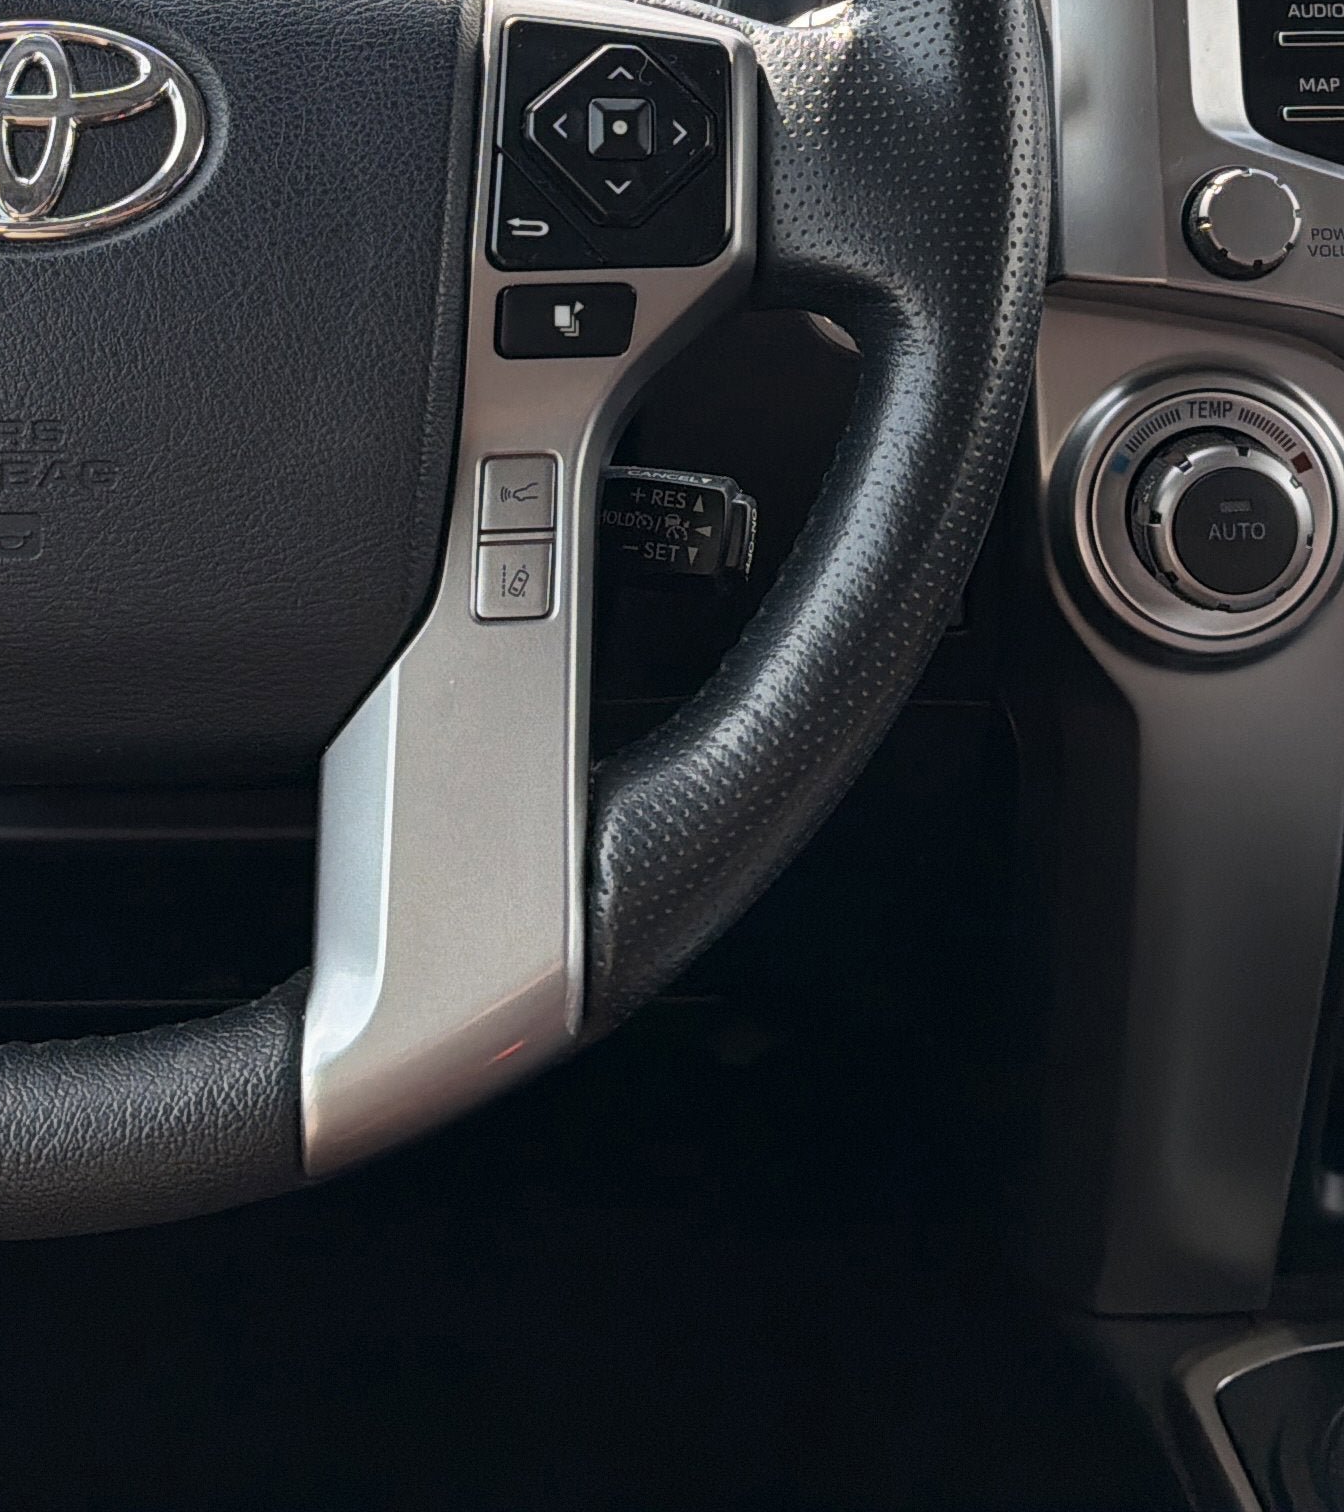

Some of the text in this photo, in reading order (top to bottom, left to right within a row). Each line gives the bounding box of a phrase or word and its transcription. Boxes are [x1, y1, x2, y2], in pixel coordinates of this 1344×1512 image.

[1299, 77, 1341, 93] MAP
[1186, 400, 1233, 421] TEMP
[627, 469, 698, 484] CANCEL
[1209, 522, 1267, 541] AUTO
[643, 543, 681, 563] SET
